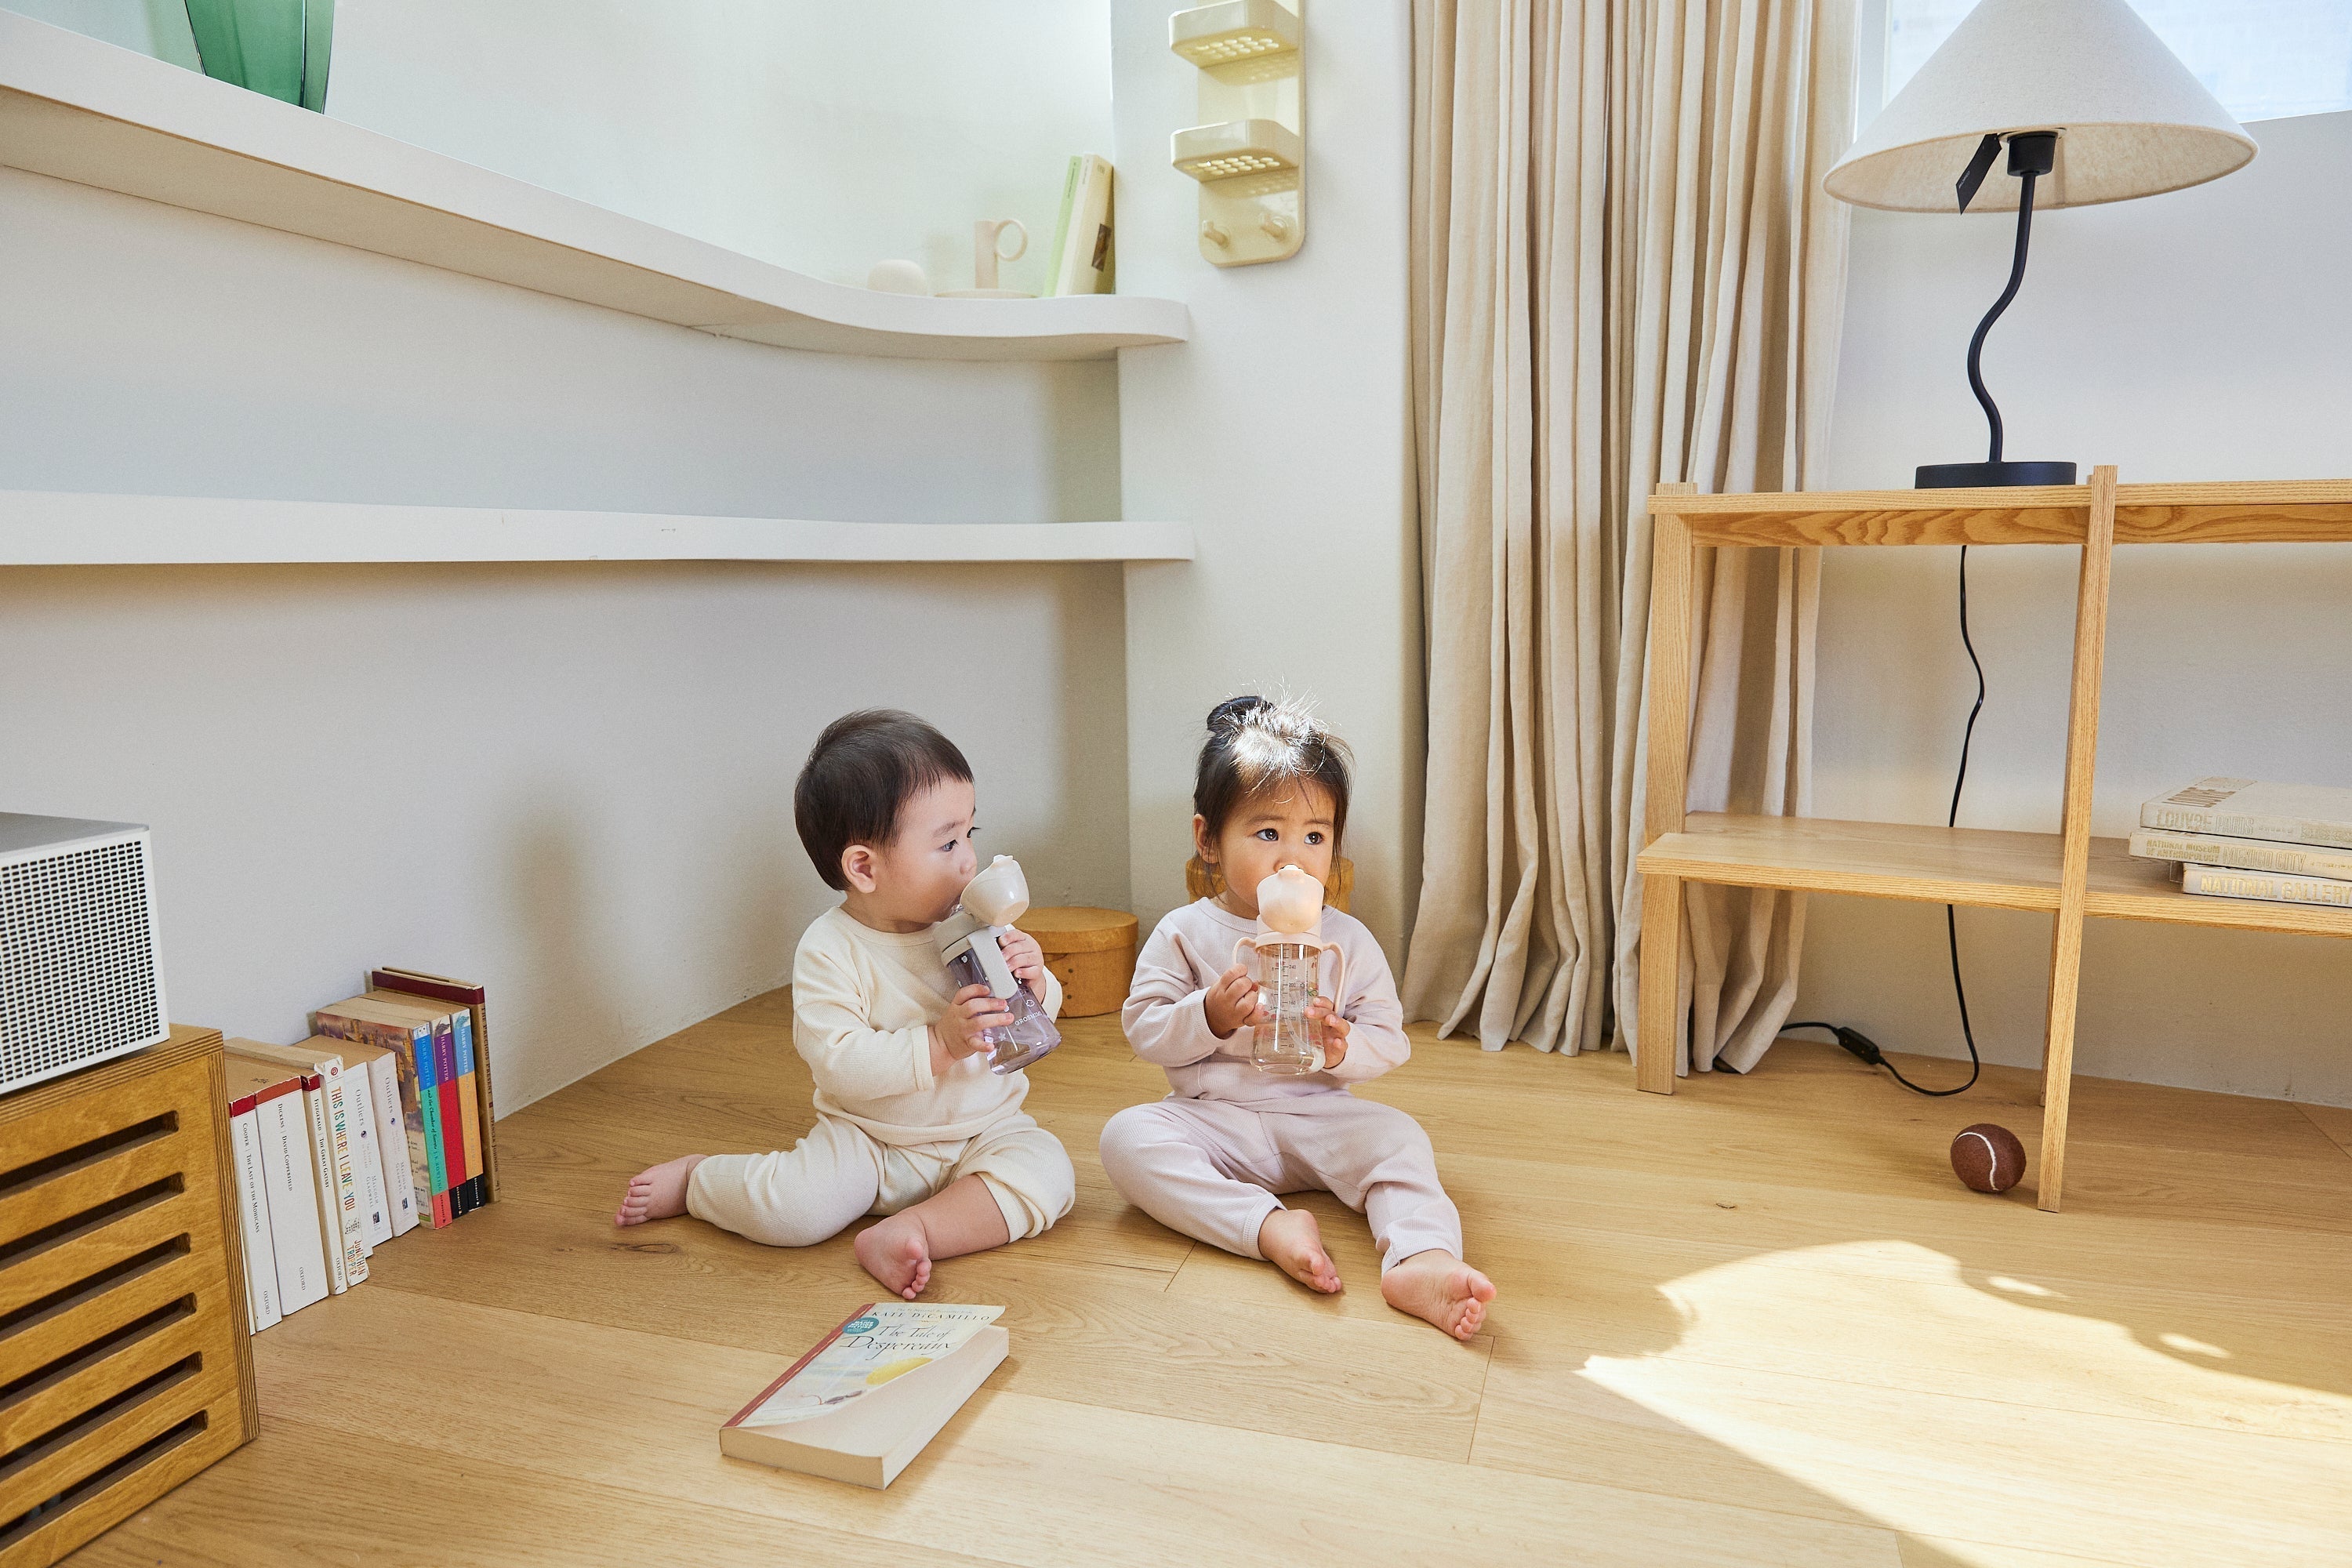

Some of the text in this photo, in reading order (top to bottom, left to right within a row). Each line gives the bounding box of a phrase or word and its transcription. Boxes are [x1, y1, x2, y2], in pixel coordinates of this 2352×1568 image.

[2157, 809, 2213, 831] LOUVRE
[2215, 815, 2255, 835] PARIS
[2146, 848, 2220, 862] OF ANTHROPOLOGY
[2147, 839, 2220, 854] NATIONAL MUSEUM
[2223, 846, 2307, 872] MEXICO CITY
[2201, 875, 2352, 905] NATIONAL GALLERY
[1014, 1011, 1043, 1026] GROSMIMI
[331, 1086, 343, 1109] THIS
[355, 1089, 364, 1127] Outliers
[385, 1076, 394, 1114] Outliers
[333, 1109, 345, 1121] IS
[335, 1120, 348, 1155] WHERE
[284, 1154, 293, 1192] COPPERFIELD
[339, 1161, 353, 1190] LEAVE
[343, 1192, 355, 1211] YOU
[252, 1202, 260, 1233] MOHICANS
[347, 1245, 358, 1277] TROPPER
[354, 1240, 366, 1276] JONATHAN
[879, 1324, 956, 1342] The Tale of
[840, 1335, 956, 1360] Despereaux
